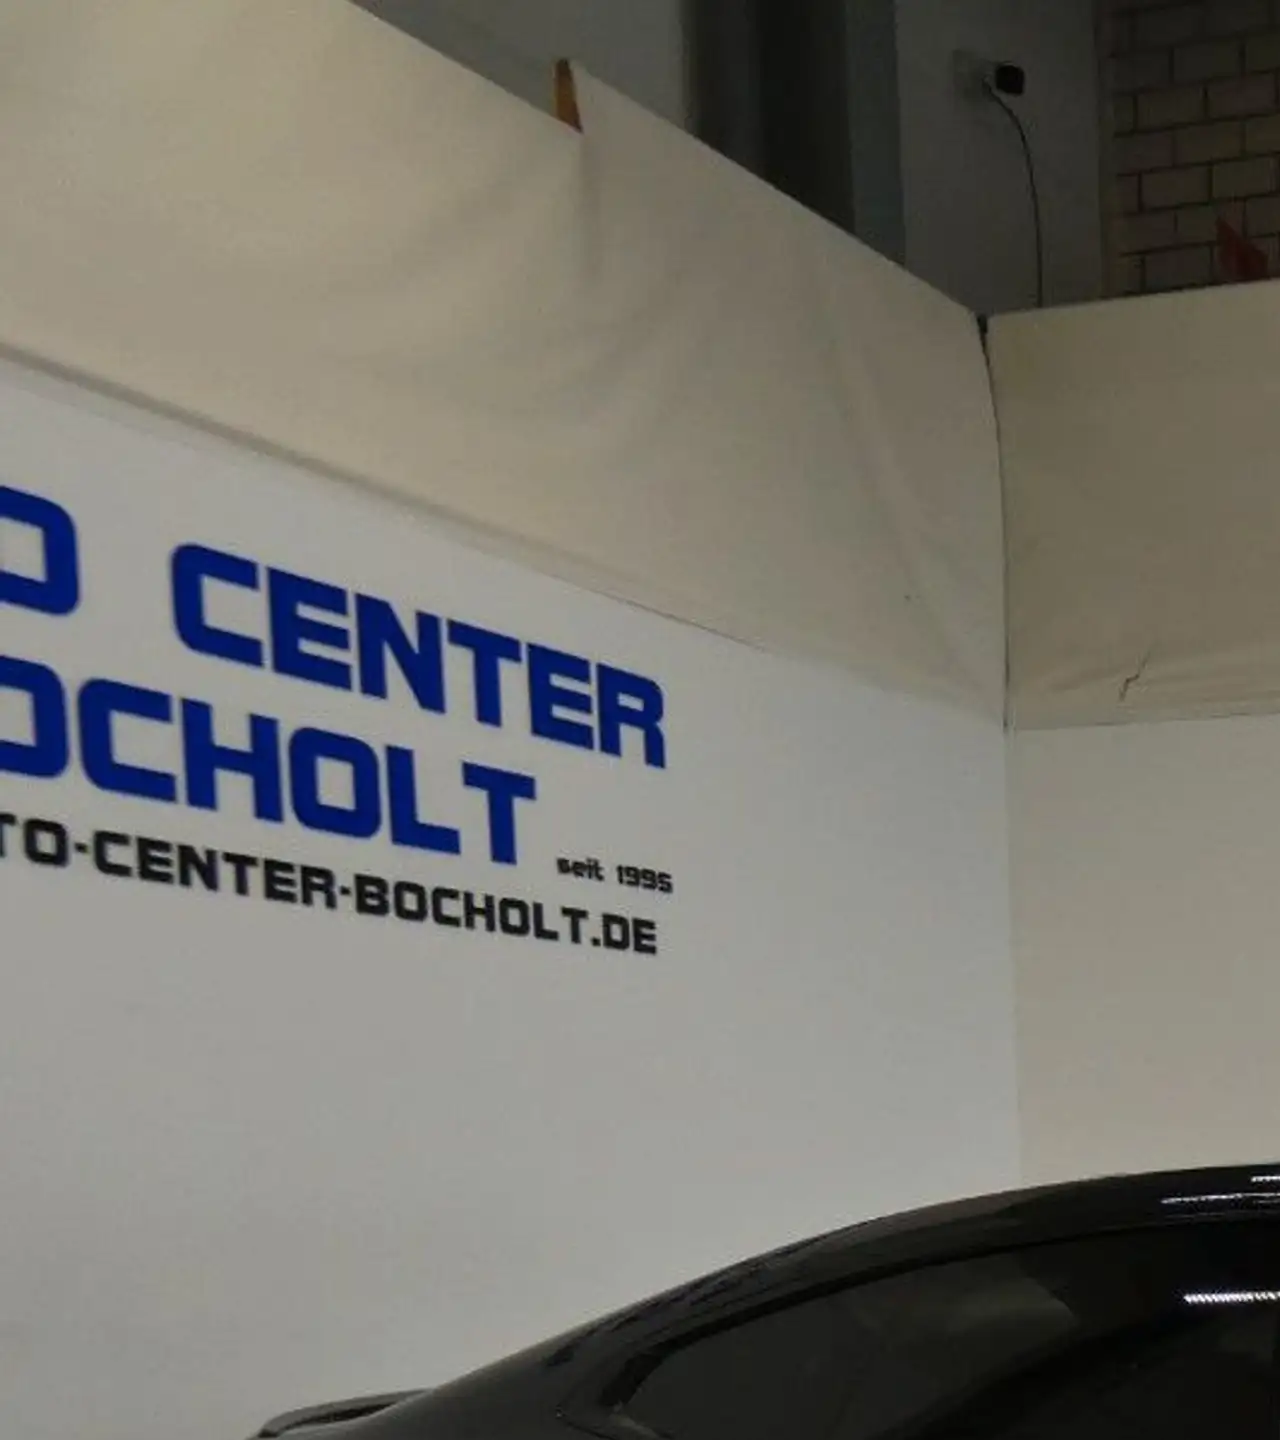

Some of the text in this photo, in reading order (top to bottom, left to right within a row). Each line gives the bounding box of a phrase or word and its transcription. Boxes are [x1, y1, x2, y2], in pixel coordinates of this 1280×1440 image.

[171, 544, 667, 770] CENTER
[556, 856, 674, 894] seit 1995
